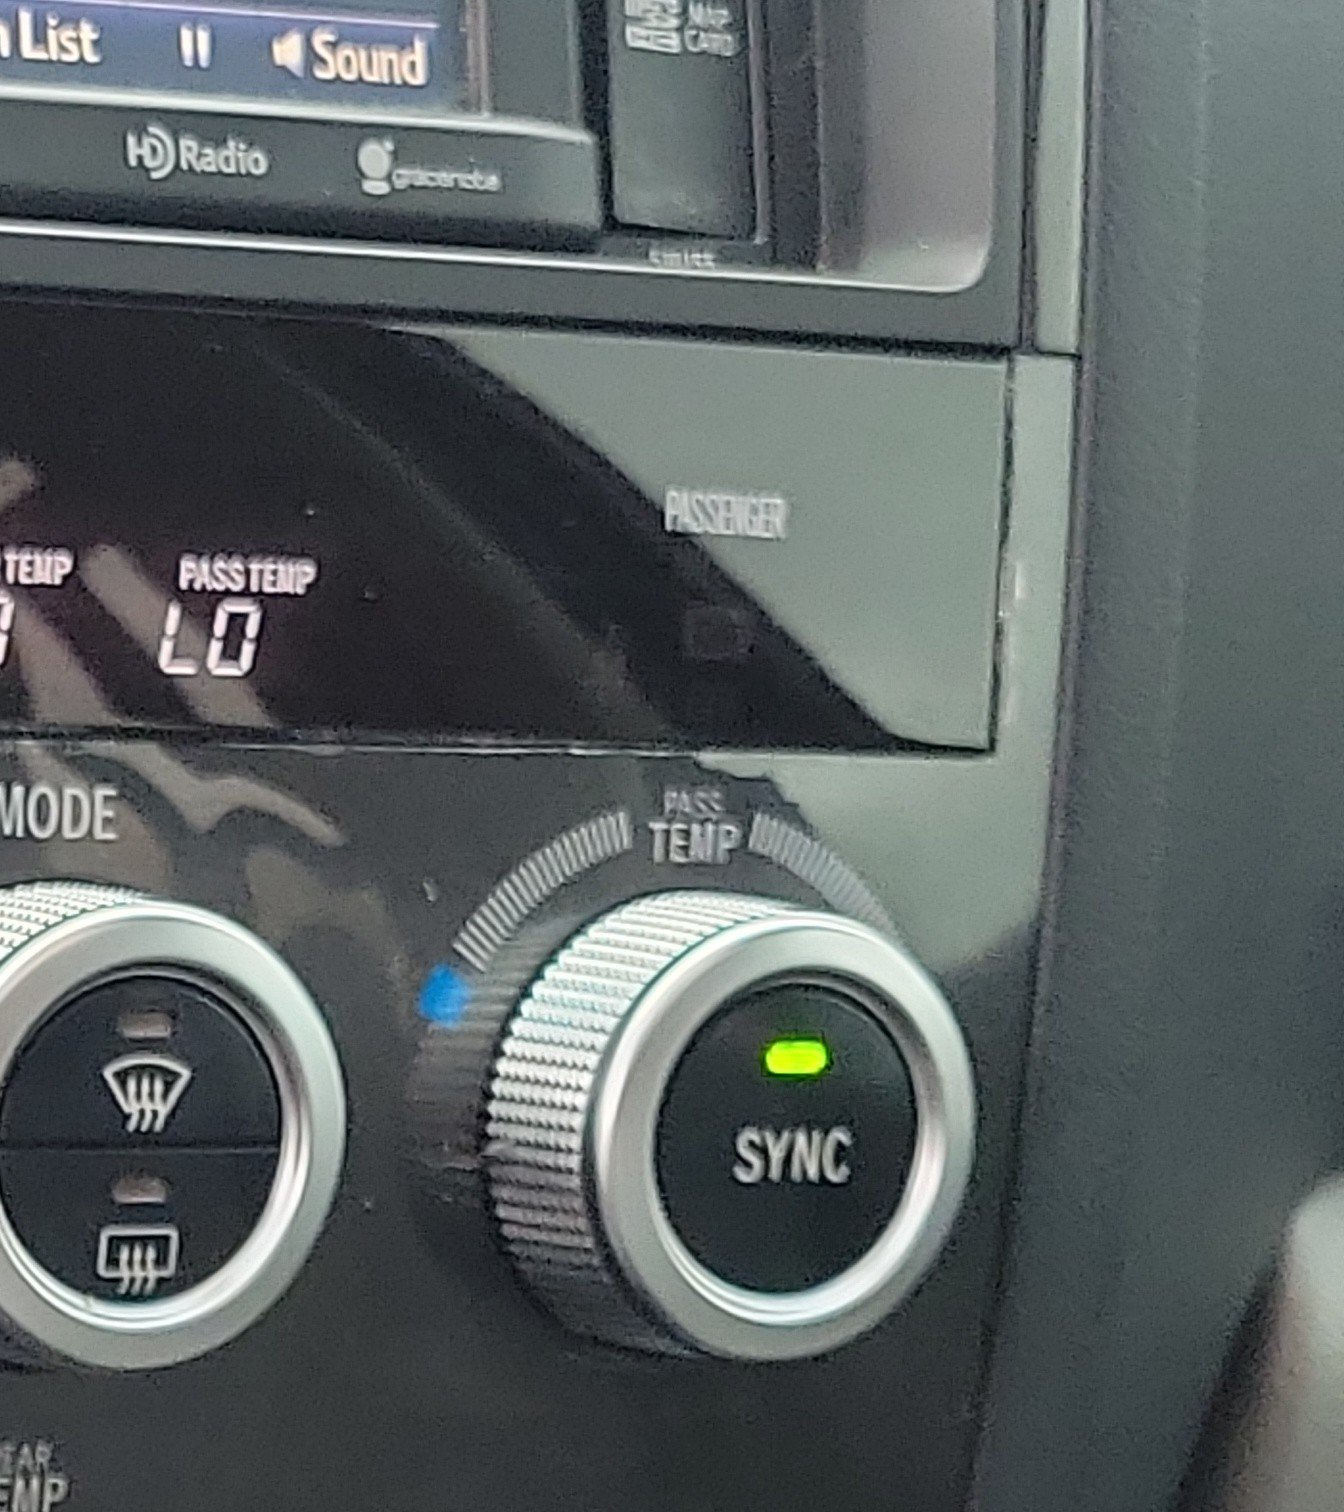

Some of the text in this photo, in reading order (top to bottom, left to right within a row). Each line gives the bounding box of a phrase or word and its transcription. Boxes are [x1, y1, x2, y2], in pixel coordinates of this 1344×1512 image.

[18, 10, 101, 64] List
[312, 33, 428, 87] Sound
[178, 136, 270, 177] Radio
[664, 486, 788, 540] PASSENGER
[3, 548, 75, 587] TEMP
[178, 553, 318, 596] PASS TEMP
[647, 819, 743, 866] TEMP
[732, 1125, 854, 1185] SYNC
